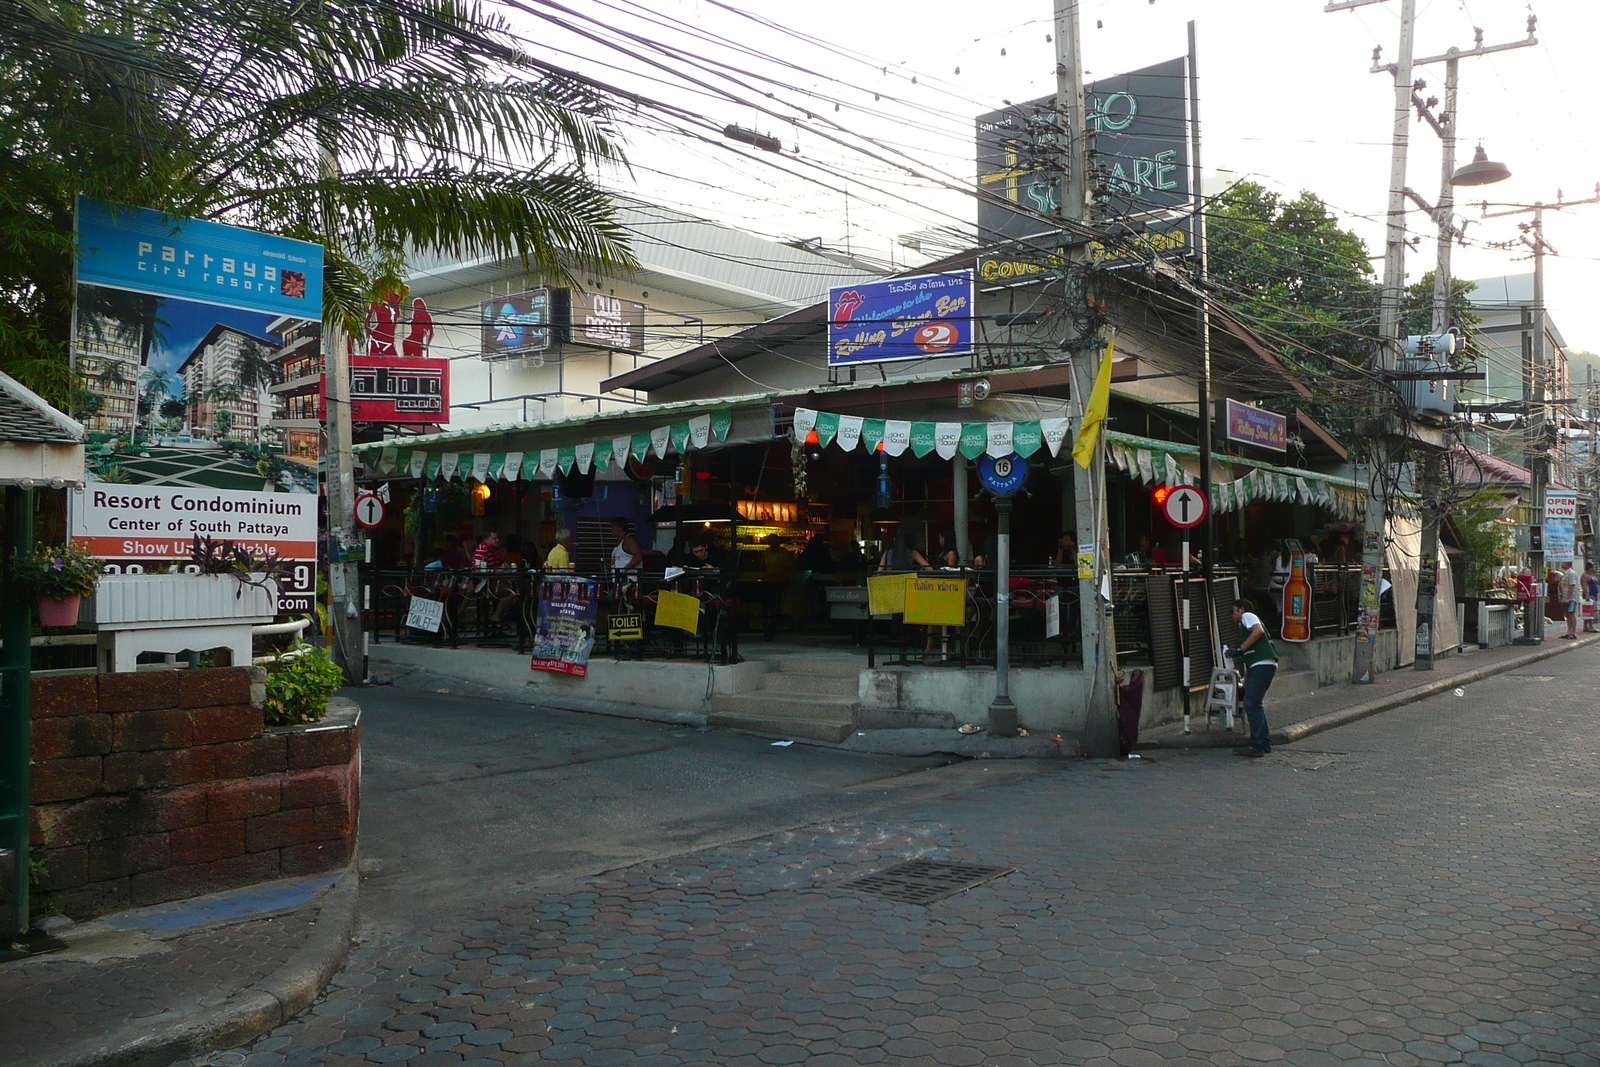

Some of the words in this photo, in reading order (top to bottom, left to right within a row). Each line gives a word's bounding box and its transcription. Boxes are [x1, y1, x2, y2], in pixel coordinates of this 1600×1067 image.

[853, 303, 902, 328] Welcome
[902, 300, 914, 311] to
[914, 290, 933, 305] the
[834, 329, 887, 360] Rolling
[935, 295, 967, 317] Bar
[922, 325, 951, 350] 2
[993, 433, 1009, 441] SOHO
[996, 462, 1009, 473] 16
[987, 476, 1018, 489] PATTAYA
[93, 491, 161, 511] Resort
[170, 494, 302, 516] Condominium
[1547, 498, 1575, 506] OPEN
[1547, 507, 1574, 516] NOW
[108, 517, 160, 531] Center
[167, 519, 183, 532] of
[189, 520, 231, 533] South
[238, 521, 289, 537] Pattaya
[122, 540, 169, 555] Show
[408, 612, 433, 630] TOILET
[611, 616, 639, 628] TOILET
